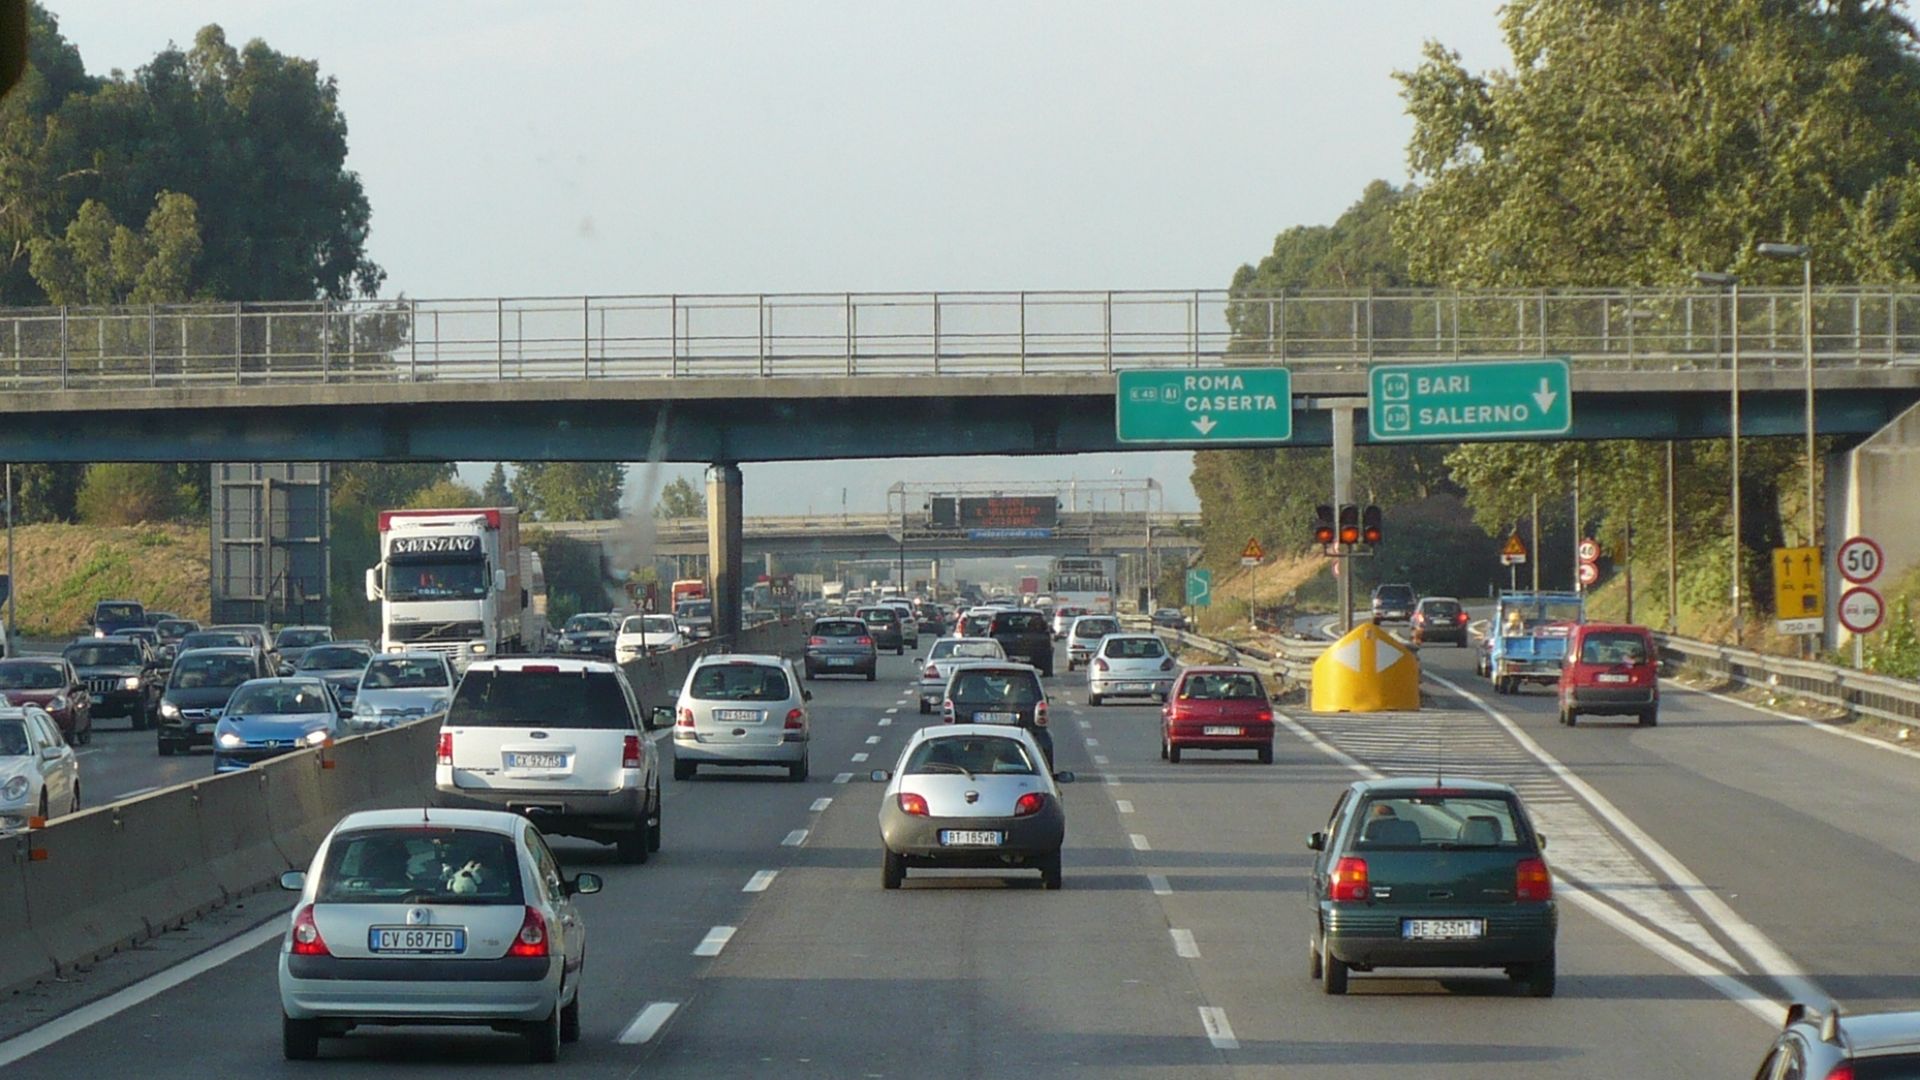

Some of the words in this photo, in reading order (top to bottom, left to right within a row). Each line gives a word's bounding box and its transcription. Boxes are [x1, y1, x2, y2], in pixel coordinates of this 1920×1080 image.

[1184, 375, 1244, 391] ROMA
[1417, 375, 1470, 395] BARI
[1165, 387, 1177, 400] A1
[1184, 395, 1277, 412] CASERTA
[1419, 403, 1529, 426] SALERNO
[393, 538, 475, 553] SAVASTANO
[1581, 546, 1593, 555] 40
[1847, 549, 1874, 572] 50
[515, 753, 528, 767] CX
[1413, 921, 1429, 936] BE
[381, 931, 400, 948] CV
[405, 931, 453, 948] 687FD
